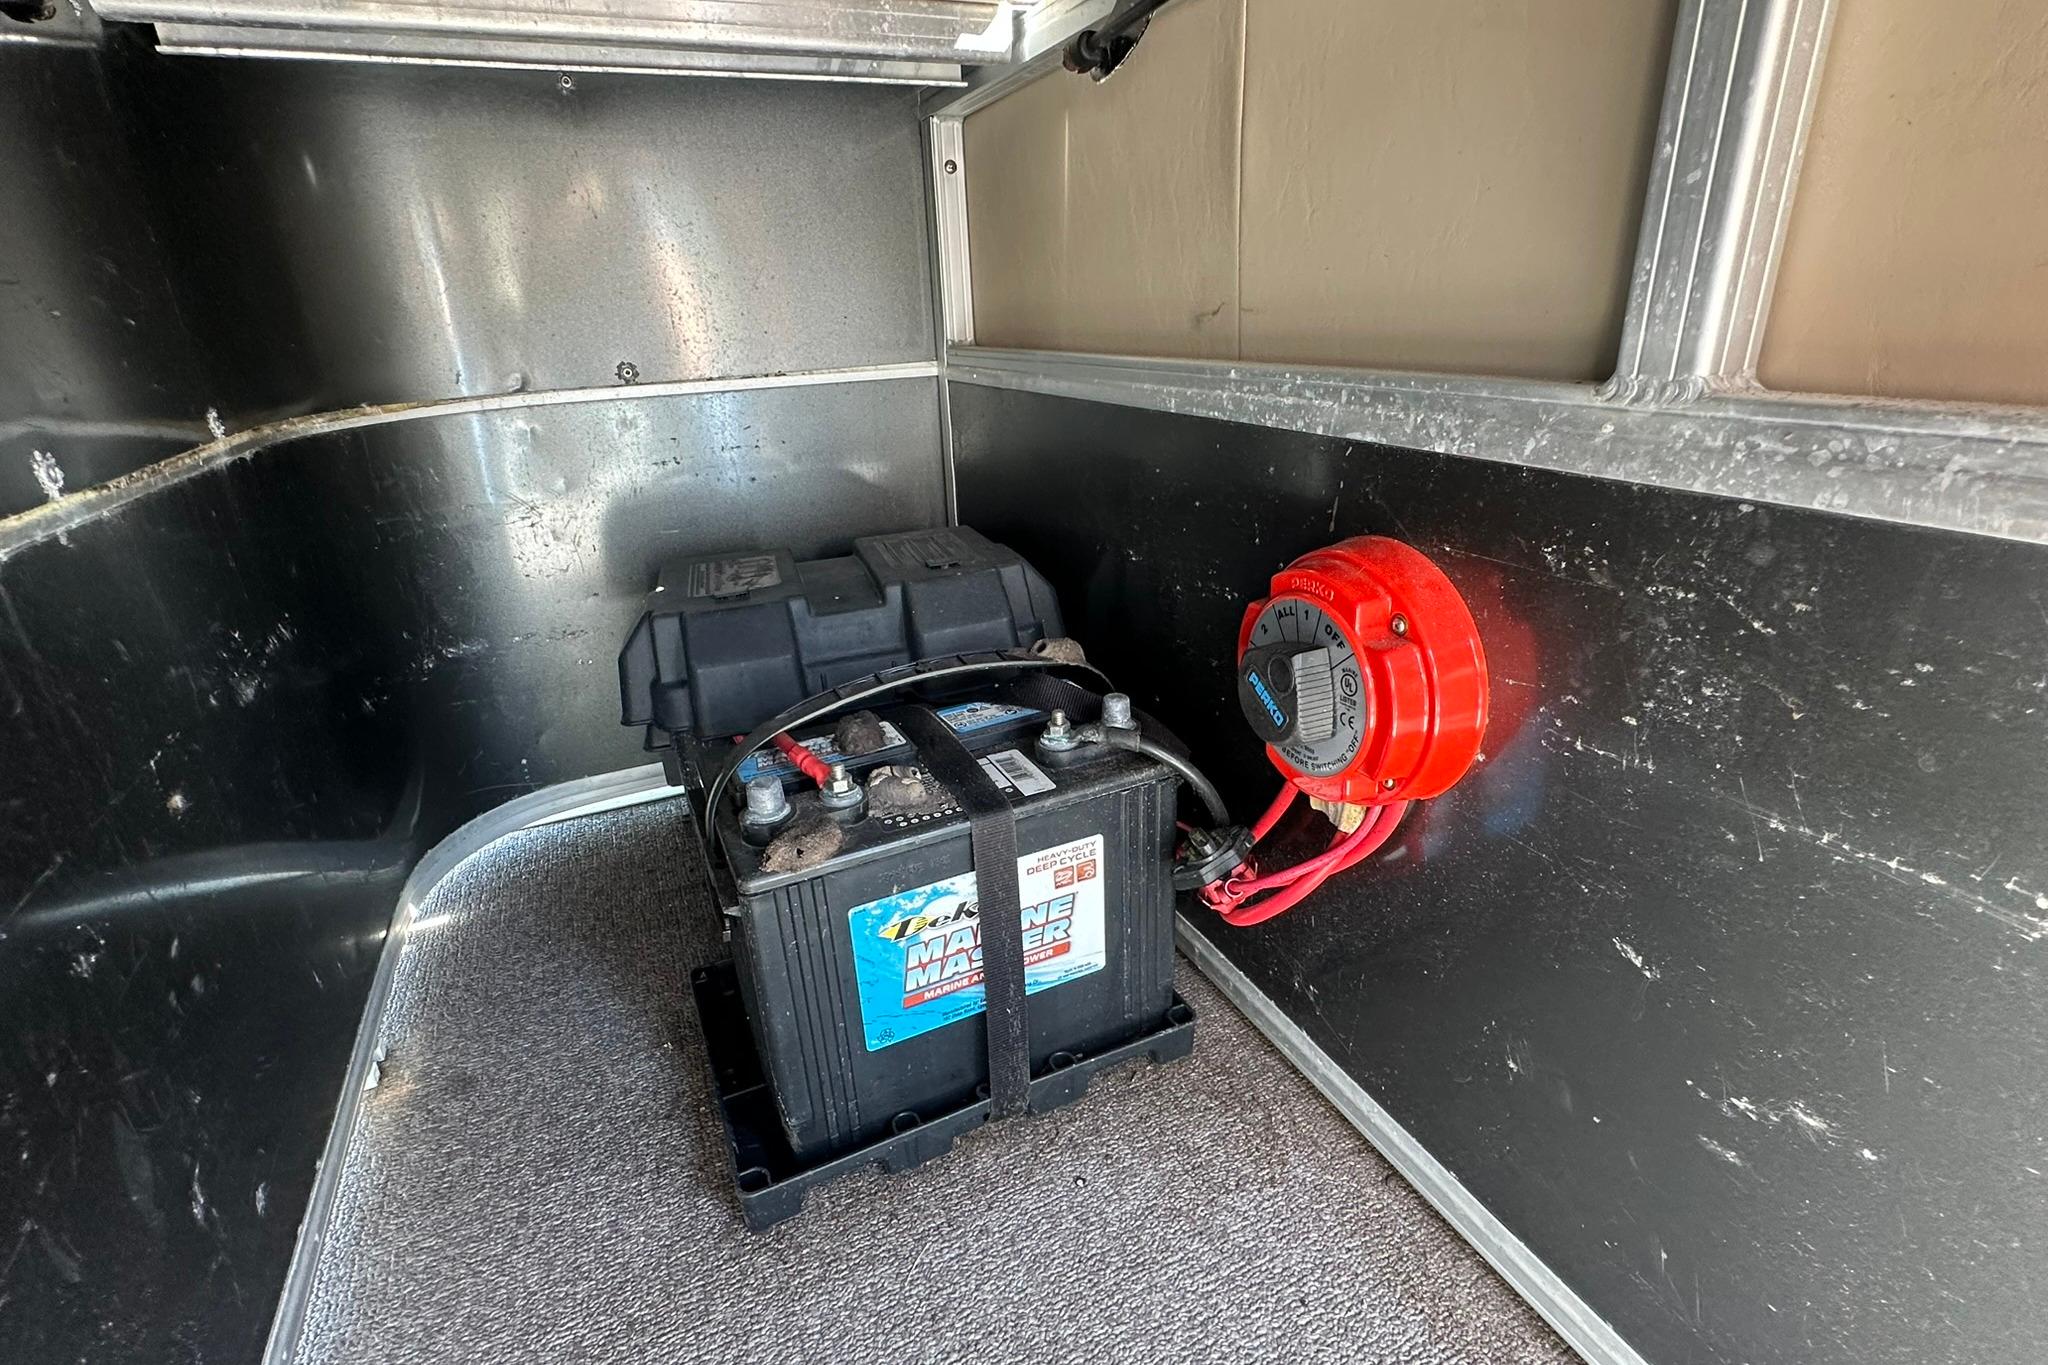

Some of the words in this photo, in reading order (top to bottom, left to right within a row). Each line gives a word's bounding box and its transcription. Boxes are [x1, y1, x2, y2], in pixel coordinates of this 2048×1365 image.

[1291, 577, 1335, 601] PERKO
[1278, 605, 1296, 620] ALL
[1304, 610, 1309, 621] 1
[1260, 624, 1269, 636] 2
[1324, 624, 1346, 652] OFF
[1247, 671, 1284, 728] PERKO
[1311, 752, 1348, 771] SWITCHING
[1026, 860, 1058, 876] DEEP
[1060, 848, 1097, 867] CYCLE
[1037, 840, 1097, 863] HEAVY-DUTY
[880, 900, 979, 941] Dek
[907, 892, 1076, 969] MANE
[923, 975, 970, 1001] MARINE
[1024, 948, 1054, 967] OWER
